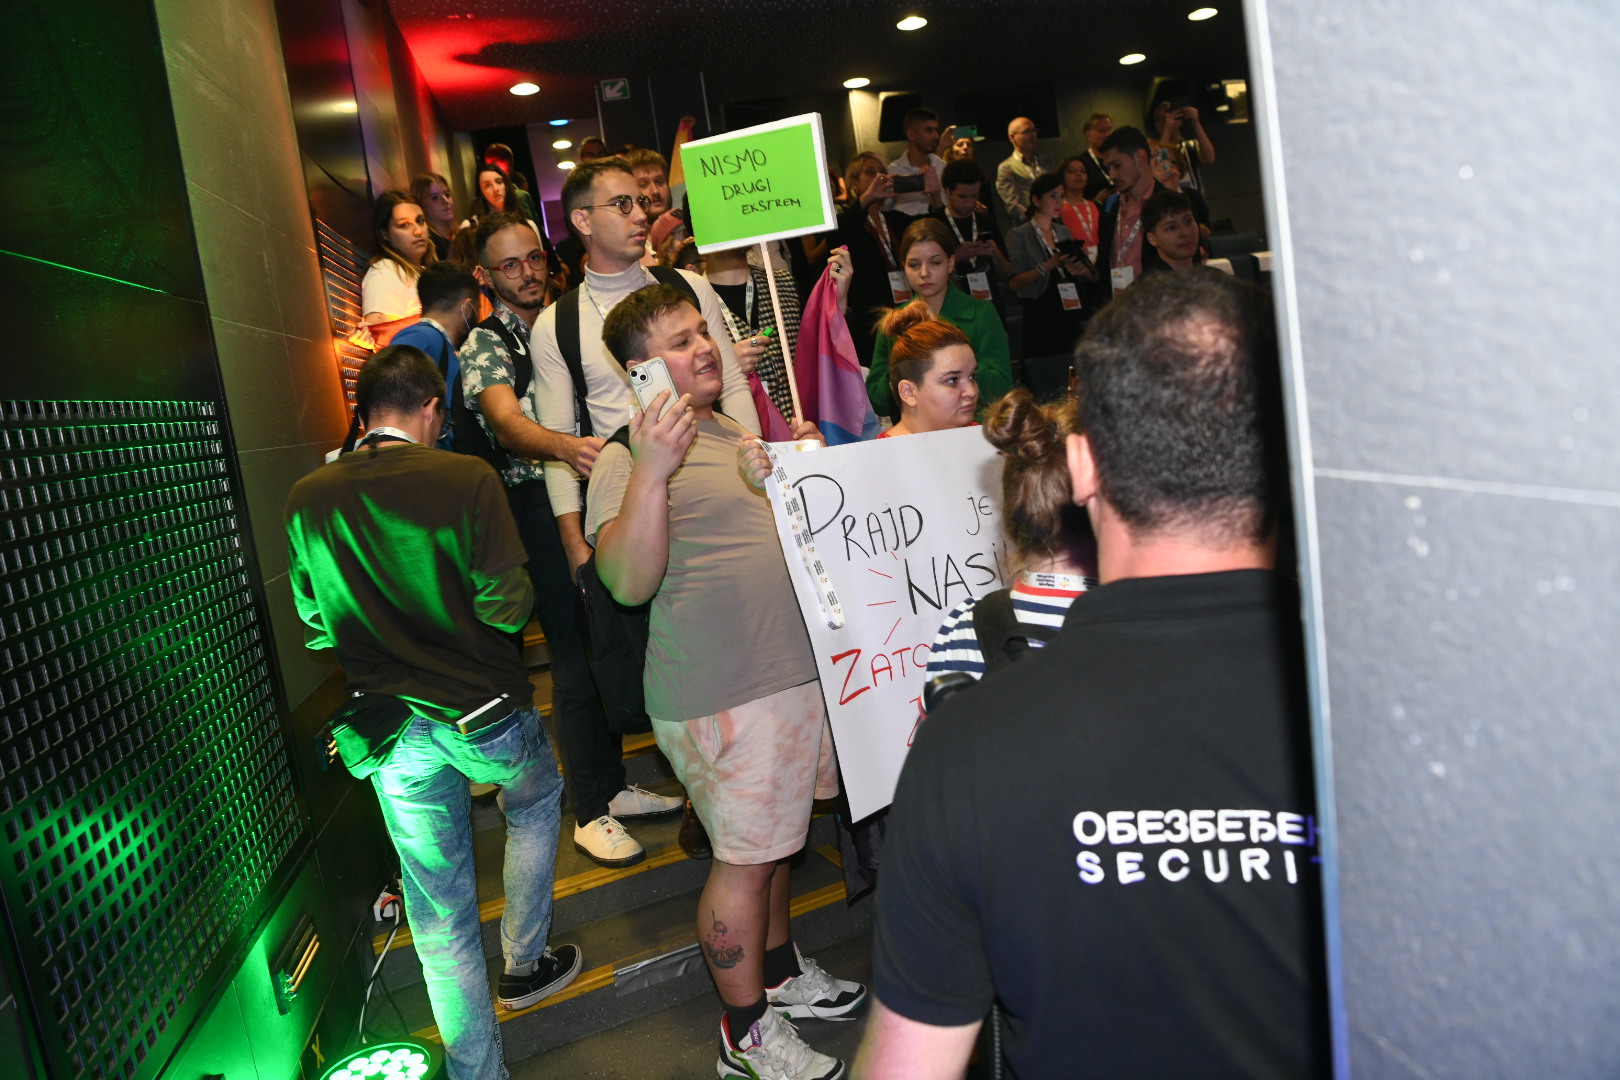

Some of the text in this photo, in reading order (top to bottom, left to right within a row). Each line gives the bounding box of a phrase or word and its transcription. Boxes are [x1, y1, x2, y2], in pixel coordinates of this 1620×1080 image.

[700, 149, 767, 177] NISMO
[721, 178, 771, 200] DRUGI
[741, 198, 801, 215] EKSTREM
[1076, 847, 1321, 884] SECURI
